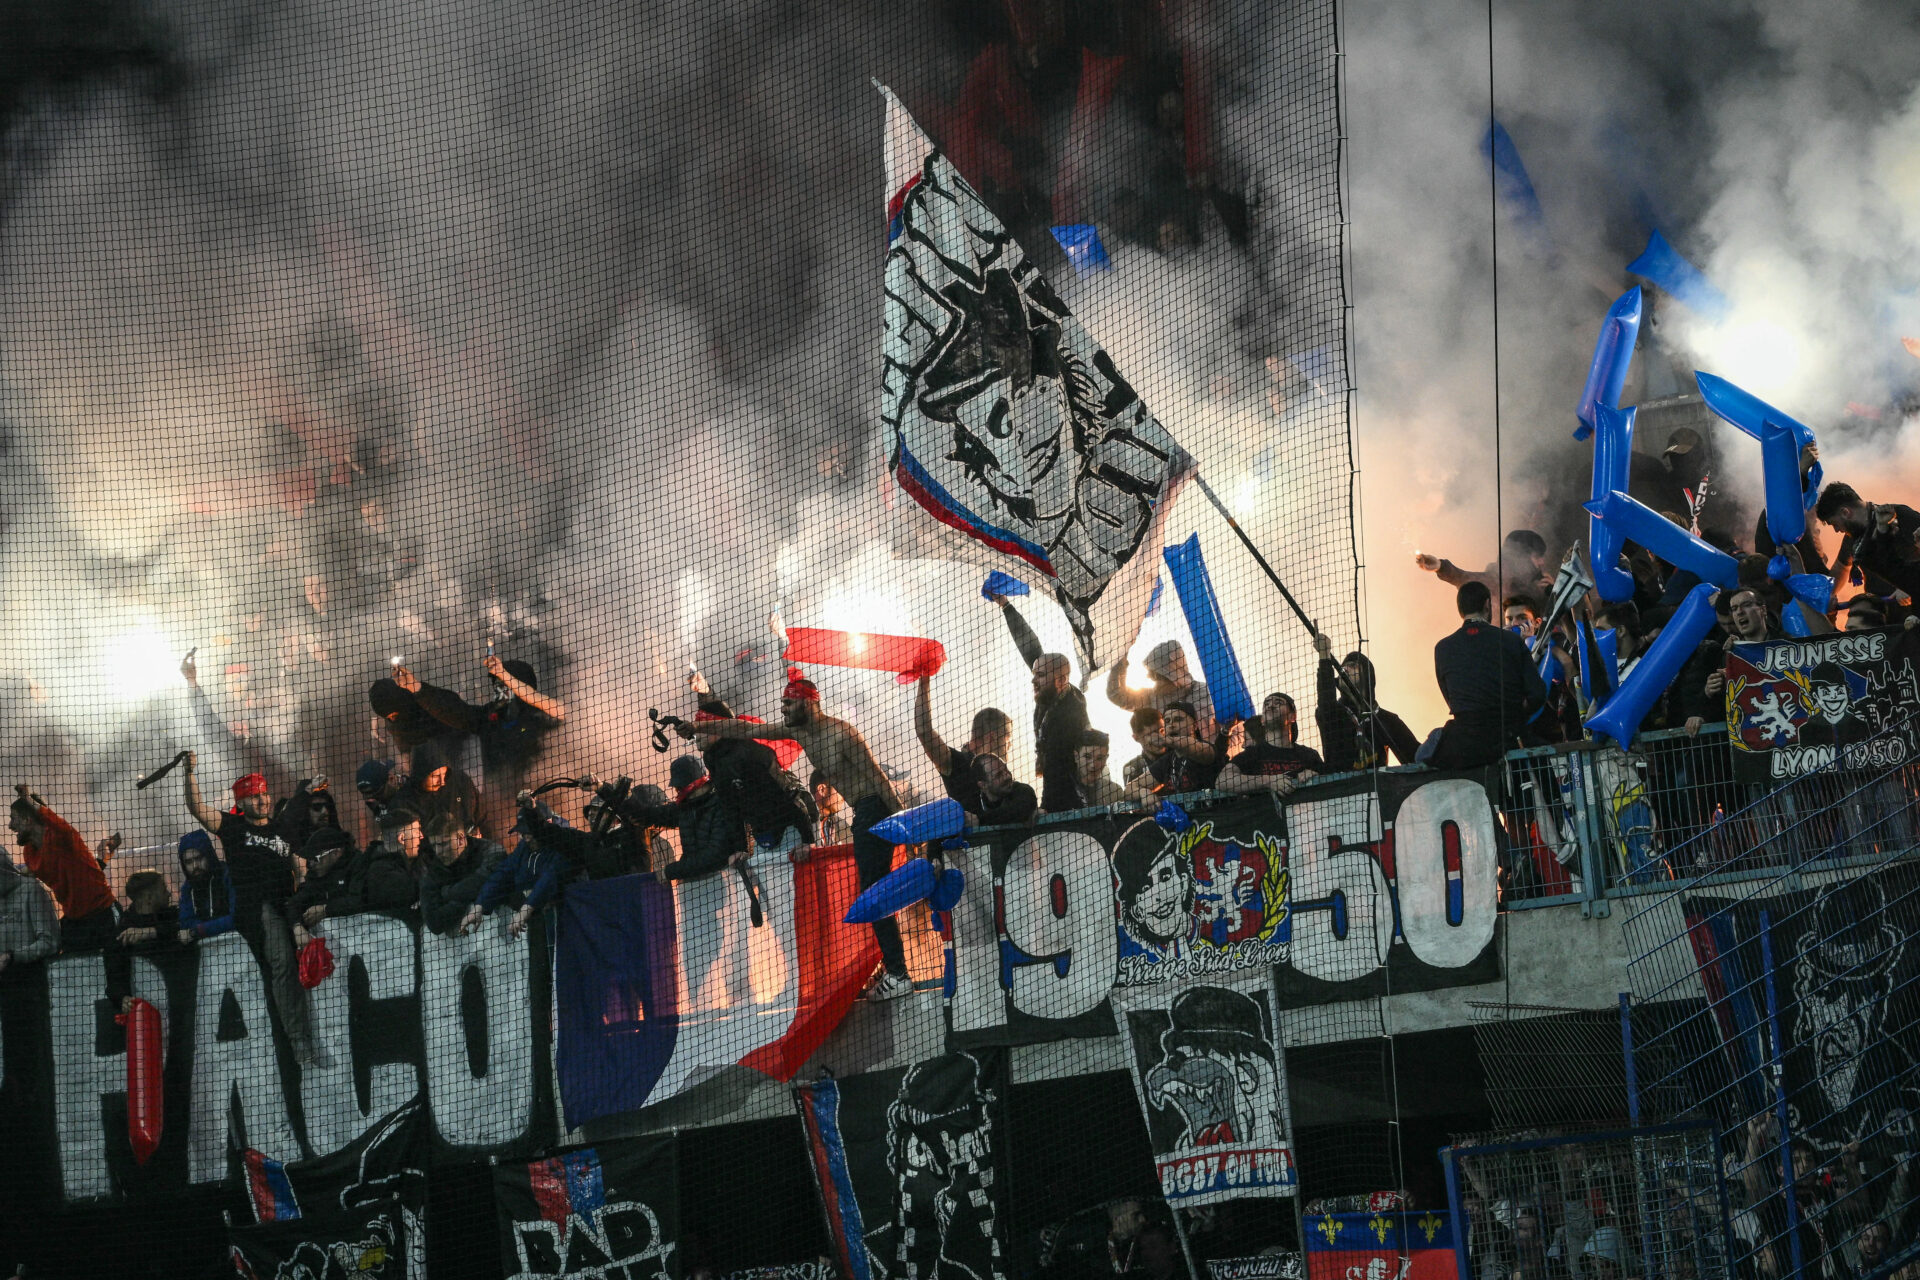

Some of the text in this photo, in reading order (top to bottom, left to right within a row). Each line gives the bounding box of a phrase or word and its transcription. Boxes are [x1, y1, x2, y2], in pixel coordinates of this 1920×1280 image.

[1756, 632, 1886, 673] JEUNESSE
[1771, 736, 1907, 778] LYON 1950
[1119, 937, 1292, 986] Virage Sud Lyon
[1225, 1153, 1252, 1186] ON
[1255, 1150, 1289, 1183] TOUR
[512, 1200, 662, 1277] BAD
